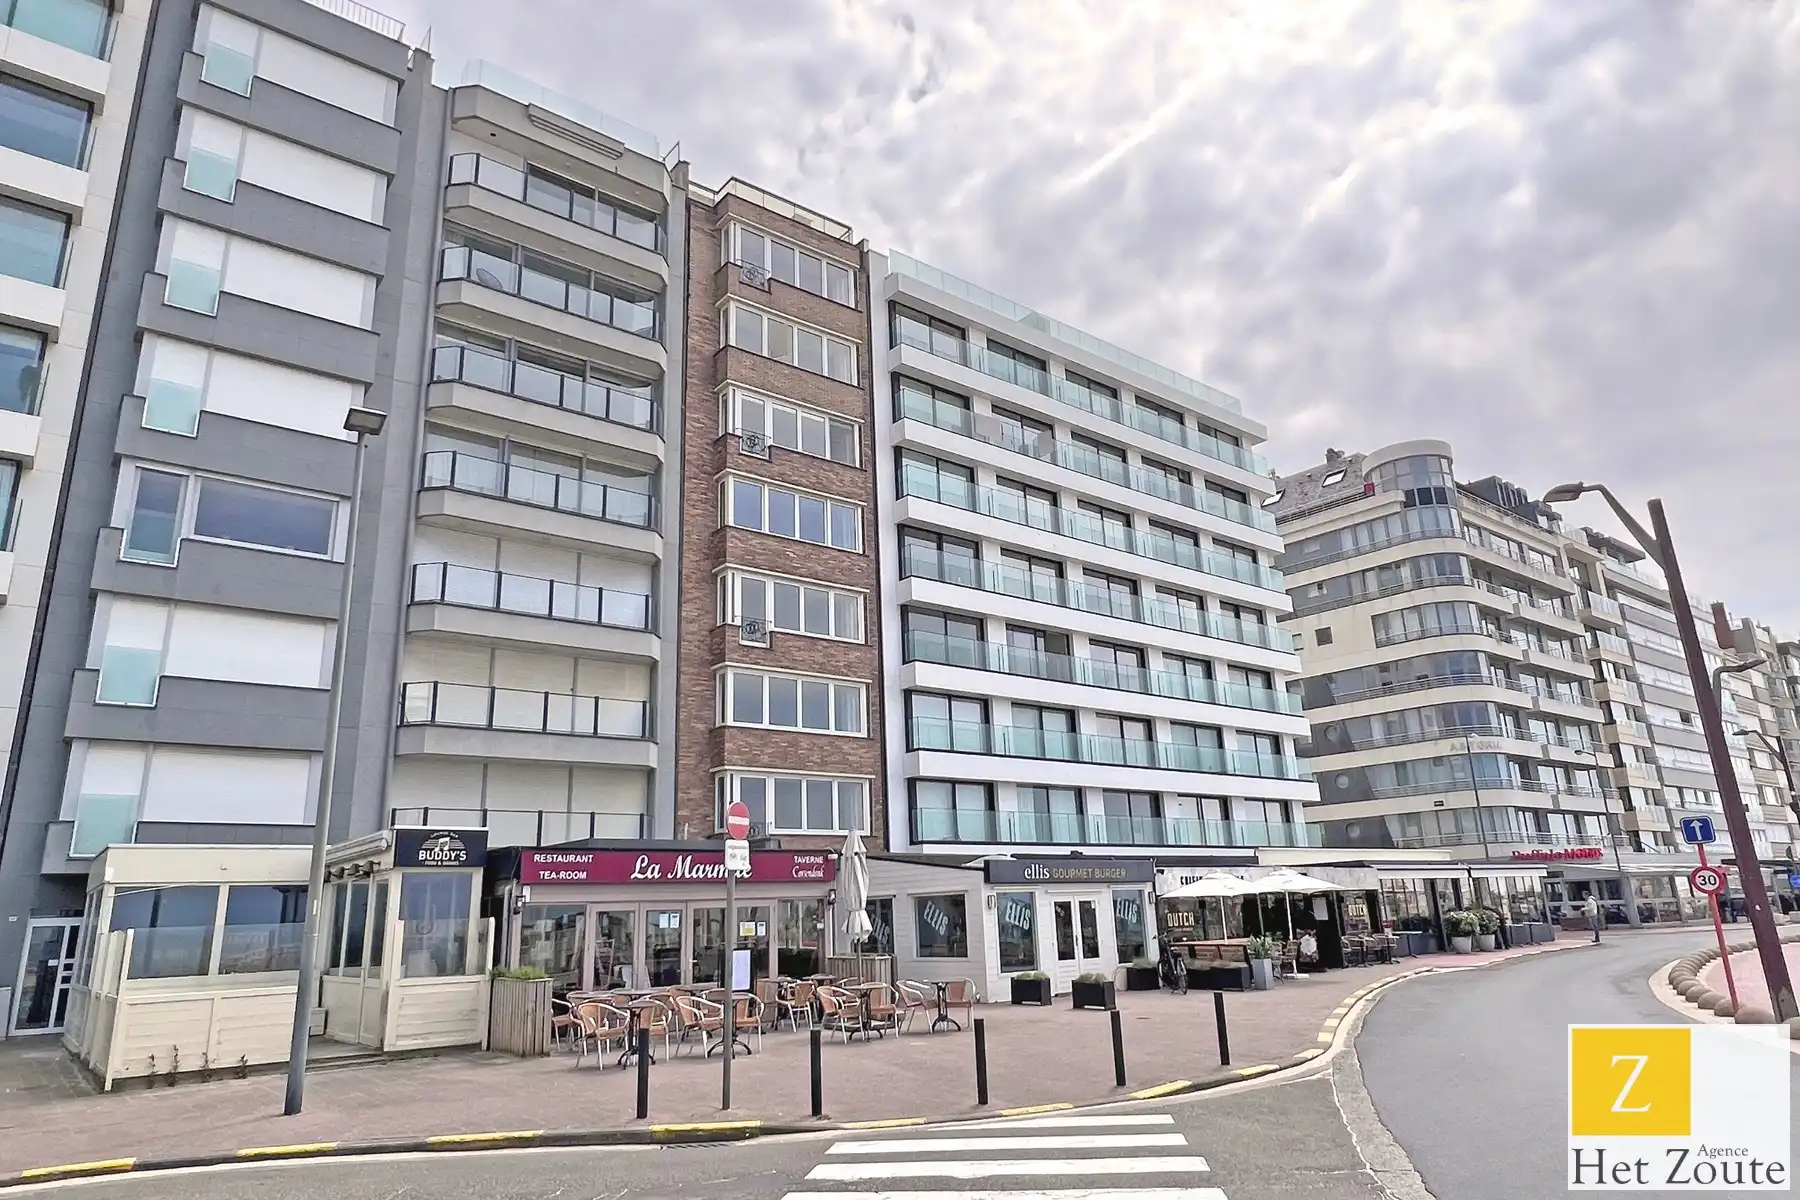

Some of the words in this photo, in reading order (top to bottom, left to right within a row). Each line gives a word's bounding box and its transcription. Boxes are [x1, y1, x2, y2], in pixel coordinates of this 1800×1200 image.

[418, 849, 467, 861] BUDDY'S
[533, 853, 594, 863] RESTAURANT
[793, 855, 824, 864] TAVERNE
[631, 854, 662, 880] La
[1024, 863, 1050, 880] ellis
[1052, 868, 1093, 879] GOURMET
[1094, 867, 1127, 879] BURGER
[539, 871, 587, 880] TEA-ROOM
[1697, 874, 1717, 886] 30
[923, 900, 949, 936] ELLIS
[1005, 900, 1031, 930] ELLIS
[1116, 898, 1138, 923] ELLIS
[1167, 911, 1195, 927] DUTCH
